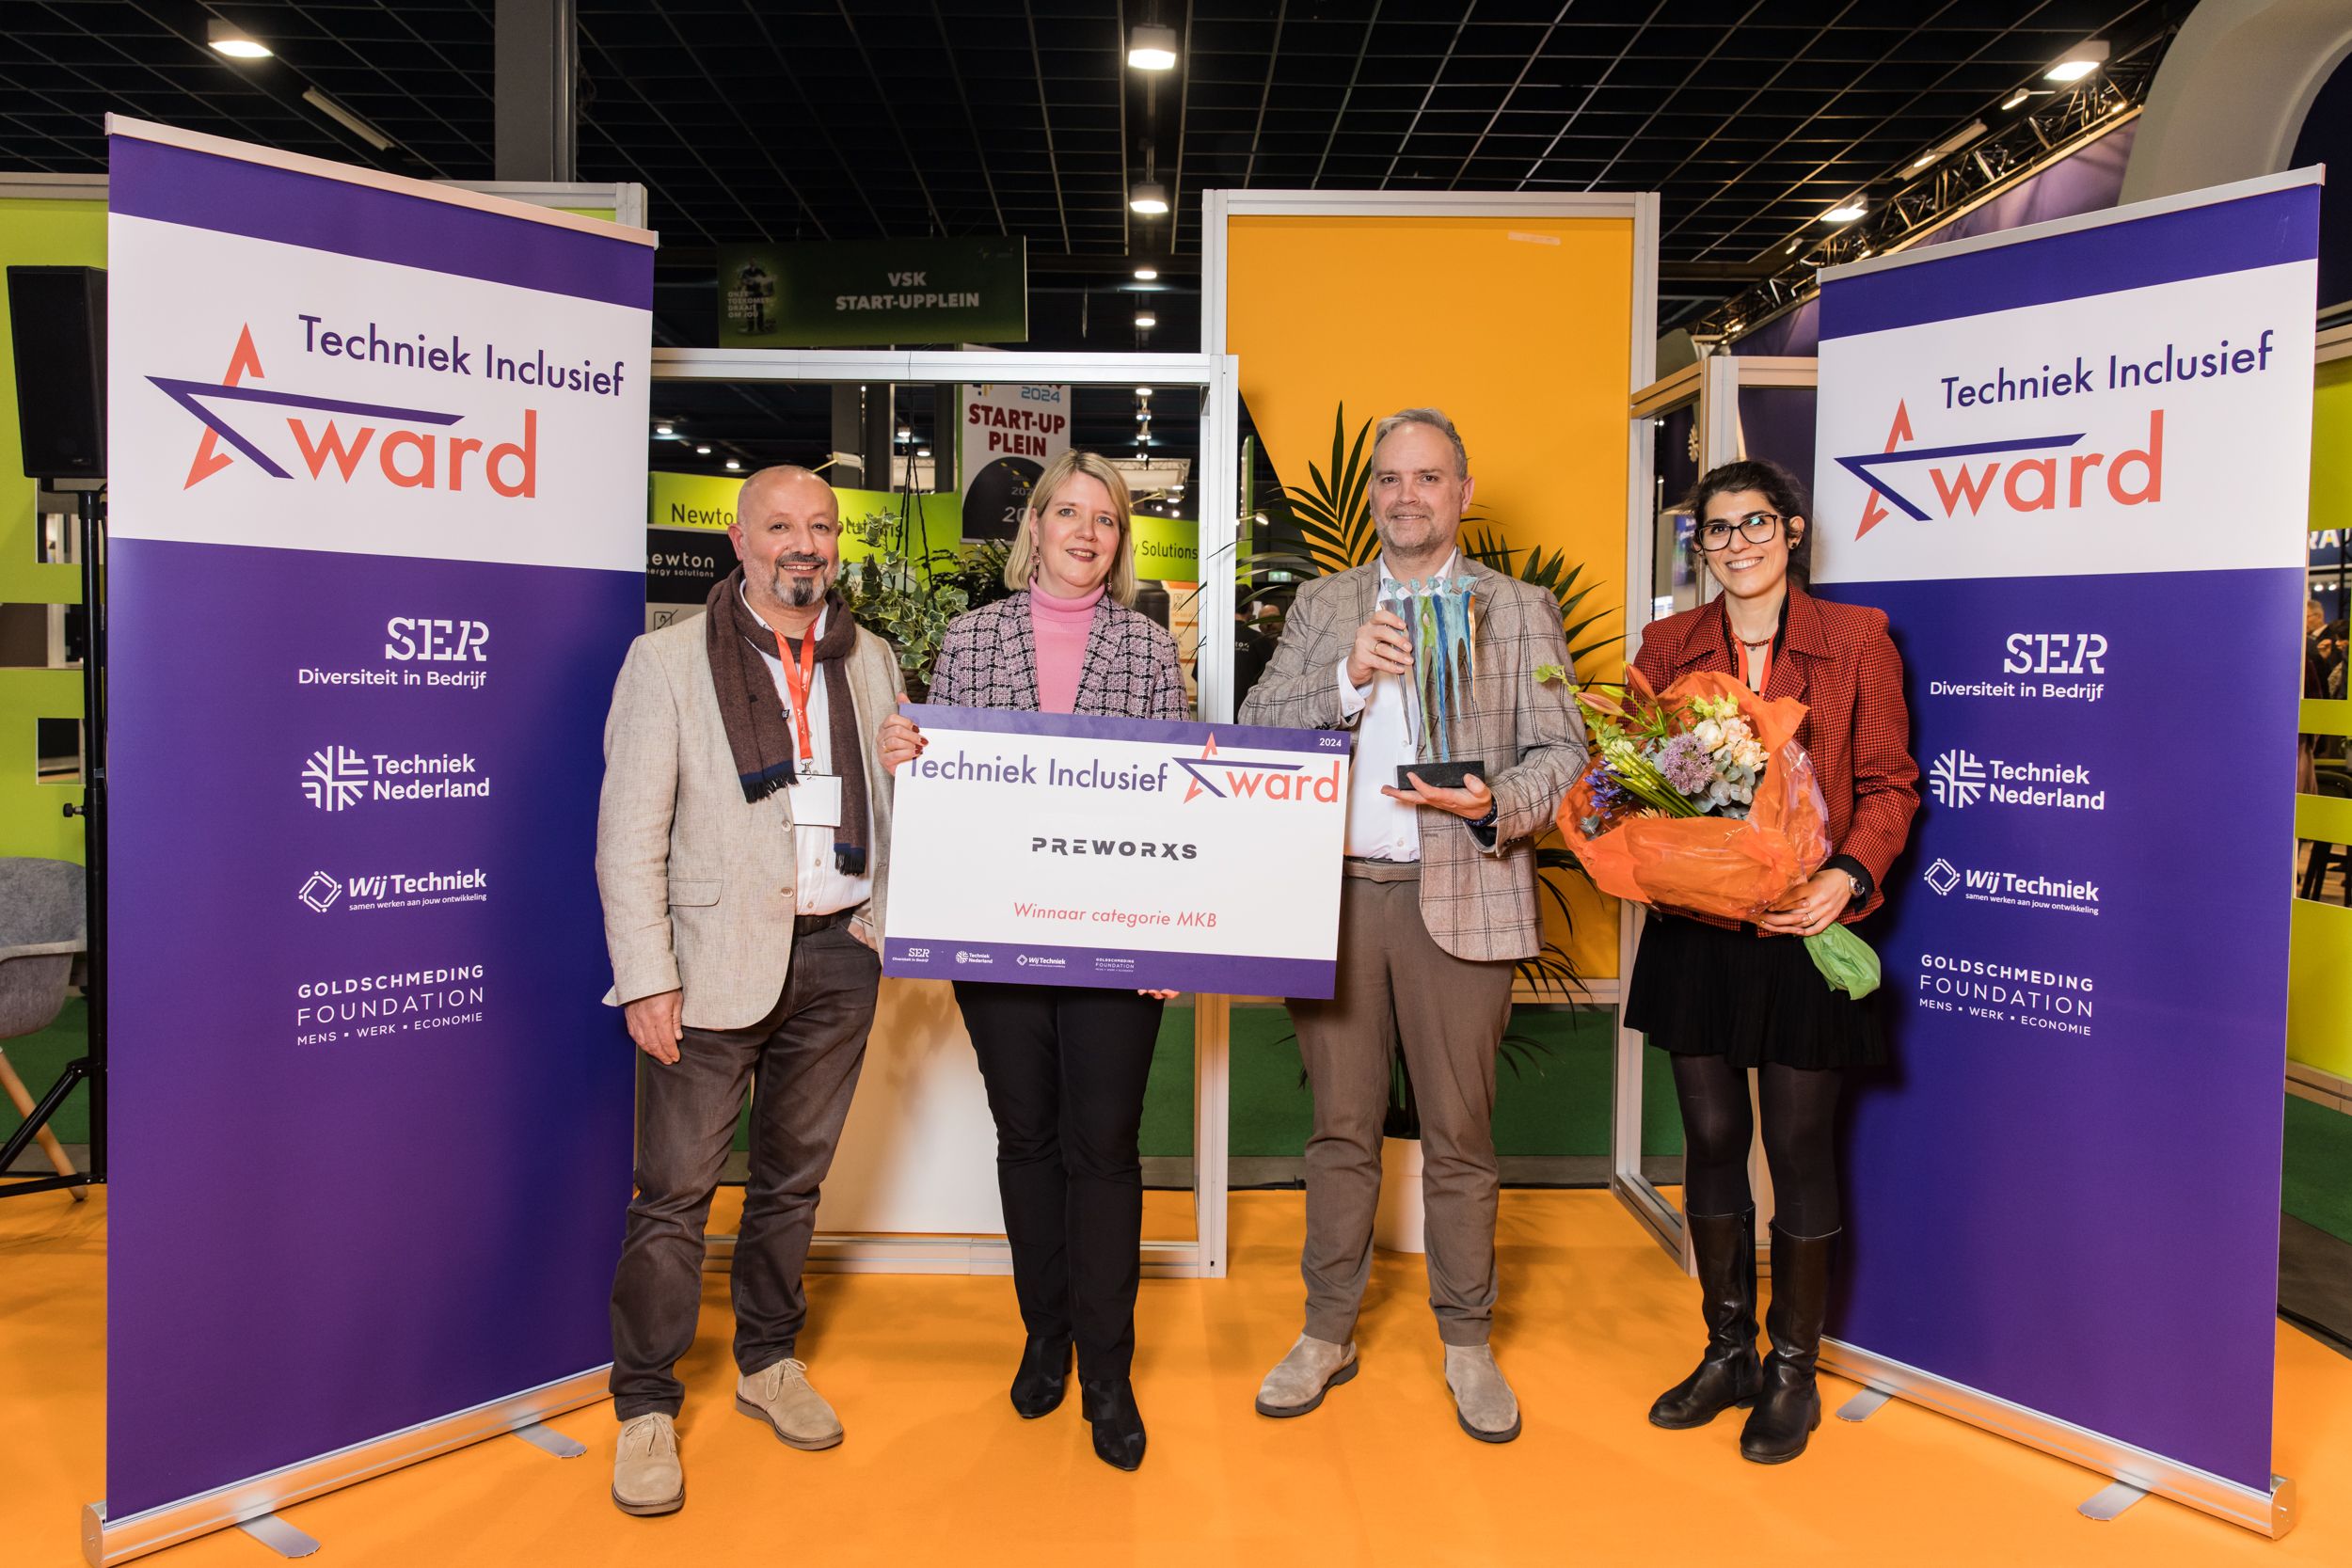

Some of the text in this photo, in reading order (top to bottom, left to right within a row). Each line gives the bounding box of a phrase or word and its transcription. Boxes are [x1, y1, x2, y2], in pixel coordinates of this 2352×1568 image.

[888, 271, 927, 287] VSK
[835, 293, 979, 311] START-UPPLEIN
[298, 312, 626, 397] Techniek Inclusief
[1941, 329, 2274, 408] Techniek Inclusief
[1021, 386, 1060, 403] 2024
[968, 403, 1065, 435] START-UP
[988, 431, 1047, 457] PLEIN
[671, 503, 734, 525] Newto
[646, 552, 714, 568] ewton
[1141, 540, 1199, 561] Solutions
[646, 568, 714, 578] nergy solutions
[385, 616, 490, 661] SER
[2003, 633, 2108, 674] SER
[298, 668, 487, 689] Diversiteit in Bedrijf
[1930, 681, 2105, 702] Diversiteit in Bedrijf
[1319, 737, 1342, 748] 2024
[372, 753, 476, 775] Techniek
[1048, 757, 1168, 792] Inclusief
[1989, 760, 2090, 784] Techniek
[373, 777, 490, 800] Nederland
[1989, 784, 2105, 810] Nederland
[1032, 837, 1198, 860] PREWORXS
[349, 868, 487, 900] Wij Techniek
[1965, 869, 2100, 901] Wij Techniek
[349, 902, 375, 911] samen
[376, 900, 405, 909] werken
[422, 896, 441, 907] jouw
[442, 893, 487, 904] ontwikkeling
[1965, 893, 1989, 901] samen
[1990, 895, 2016, 904] werken
[2031, 899, 2050, 909] jouw
[2051, 902, 2099, 915] ontwikkeling
[1014, 902, 1217, 928] Winnaar categorie MKB
[908, 947, 930, 958] SER
[297, 964, 485, 999] GOLDSCHMEDING
[1921, 954, 2093, 991] GOLDSCHMEDING
[297, 987, 484, 1026] FOUNDATION
[1920, 974, 2092, 1018] FOUNDATION
[297, 1012, 483, 1046] MENS WERK ECONOMIE
[1919, 998, 2091, 1036] MENS WERK ECONOMIE
